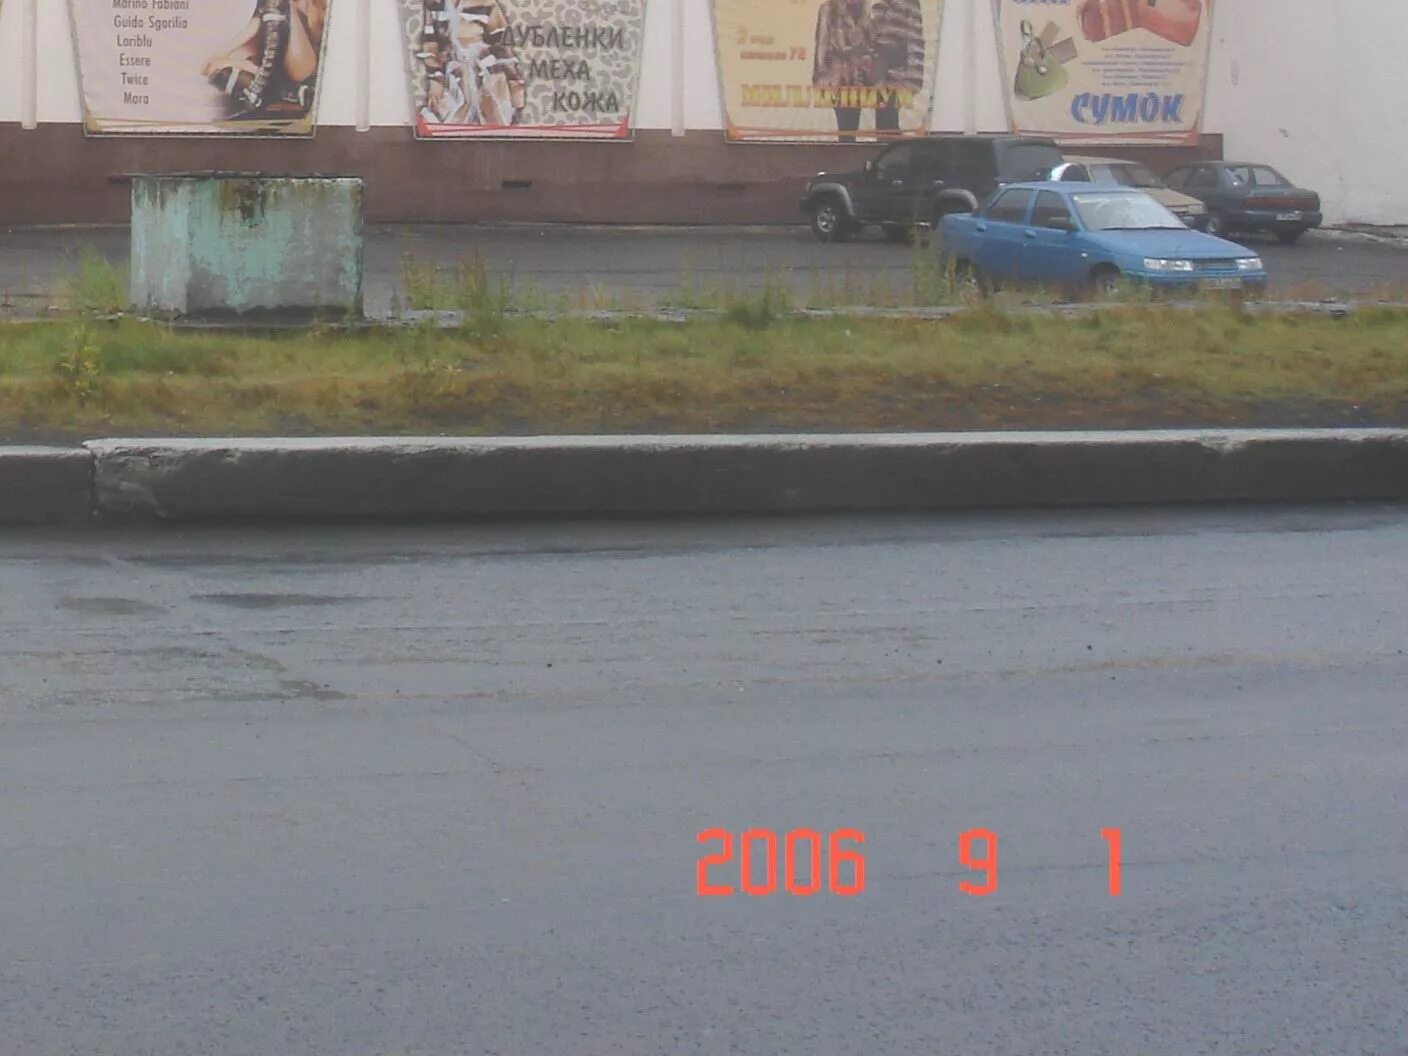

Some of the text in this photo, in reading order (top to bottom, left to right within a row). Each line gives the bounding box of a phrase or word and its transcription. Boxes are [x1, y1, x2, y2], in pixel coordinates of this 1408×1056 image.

[114, 14, 144, 28] Guido
[117, 34, 152, 47] Loriblu
[502, 24, 625, 49] ДУБЛЕНКИ
[119, 53, 151, 66] Essere
[529, 58, 591, 81] МЕХА
[120, 72, 149, 85] Twice
[123, 91, 149, 104] Mara
[553, 90, 620, 112] КОЖА
[1070, 91, 1185, 125] СУМОК
